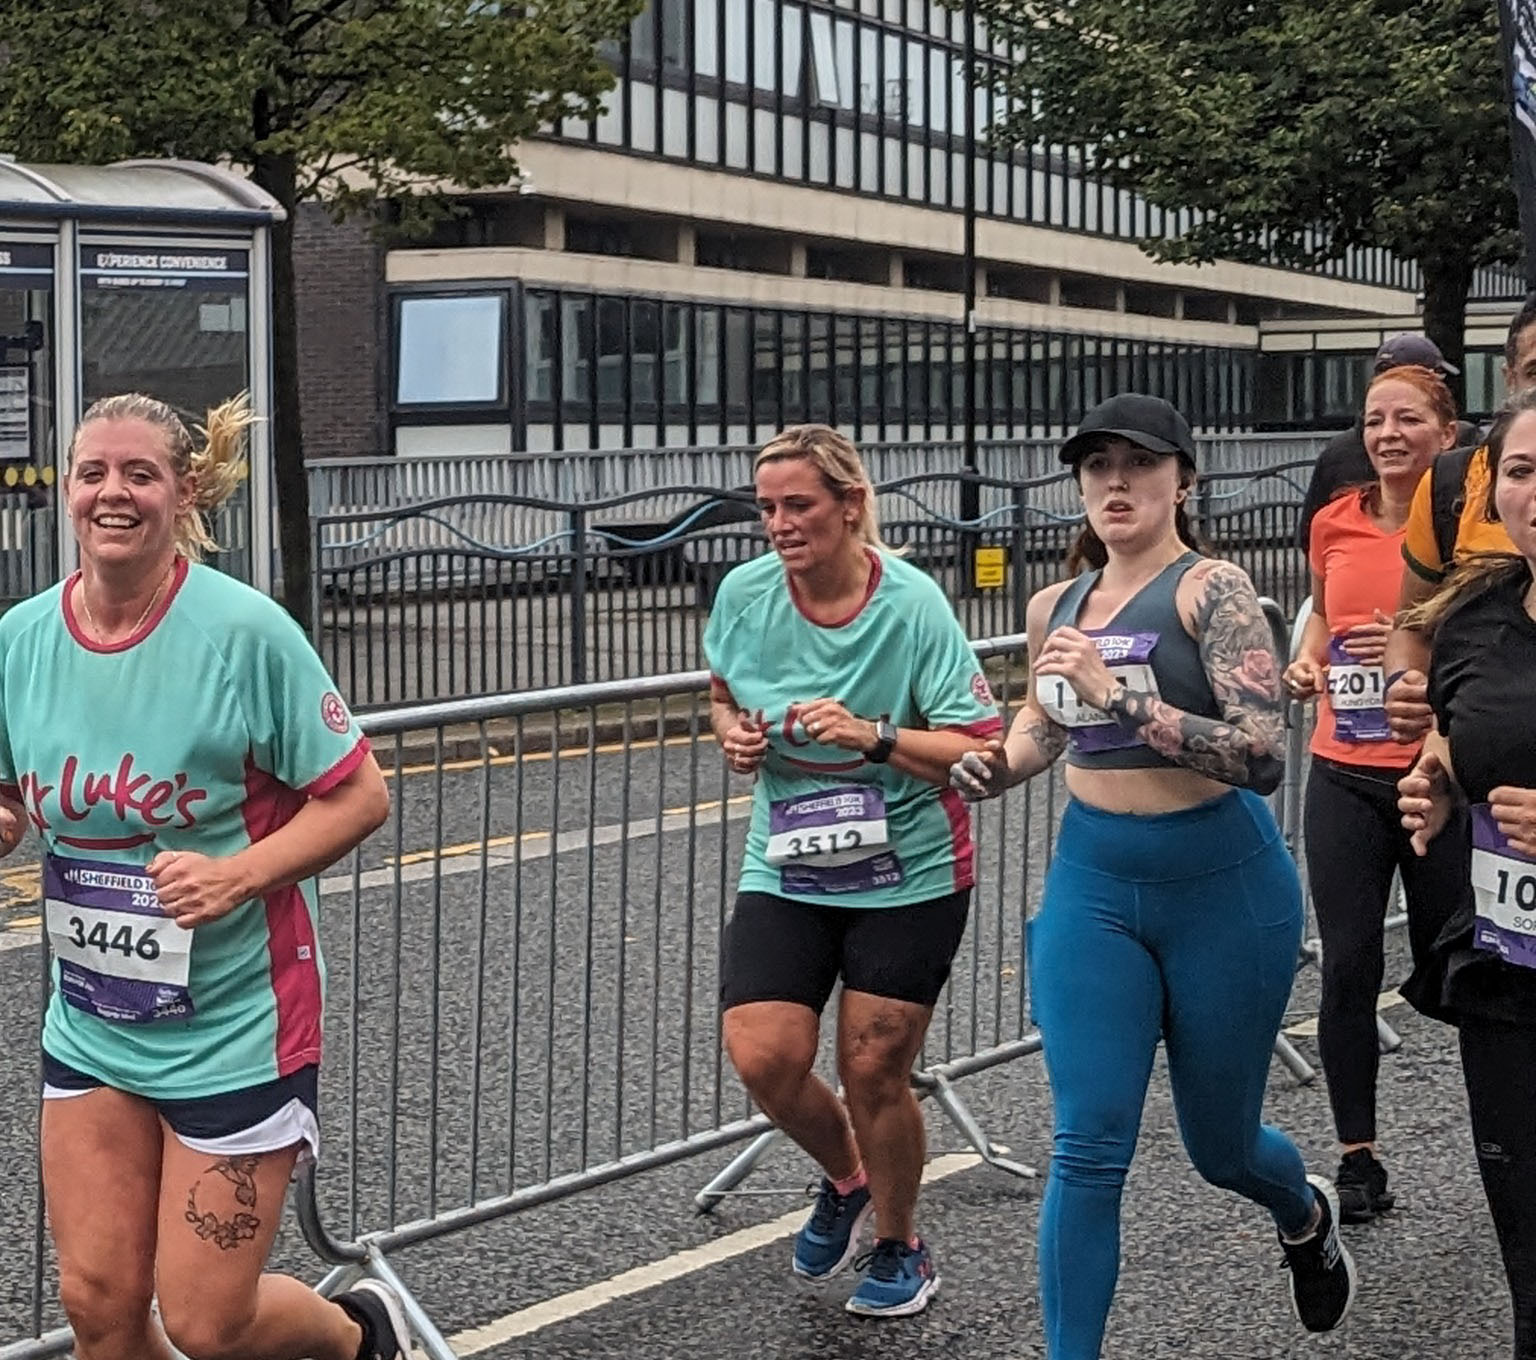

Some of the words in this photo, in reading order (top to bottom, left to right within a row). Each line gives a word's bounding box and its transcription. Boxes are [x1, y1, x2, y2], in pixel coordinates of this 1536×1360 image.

[786, 829, 863, 859] 3512
[81, 871, 144, 890] SHEFFIELD
[131, 894, 165, 908] 202
[68, 916, 161, 961] 3446
